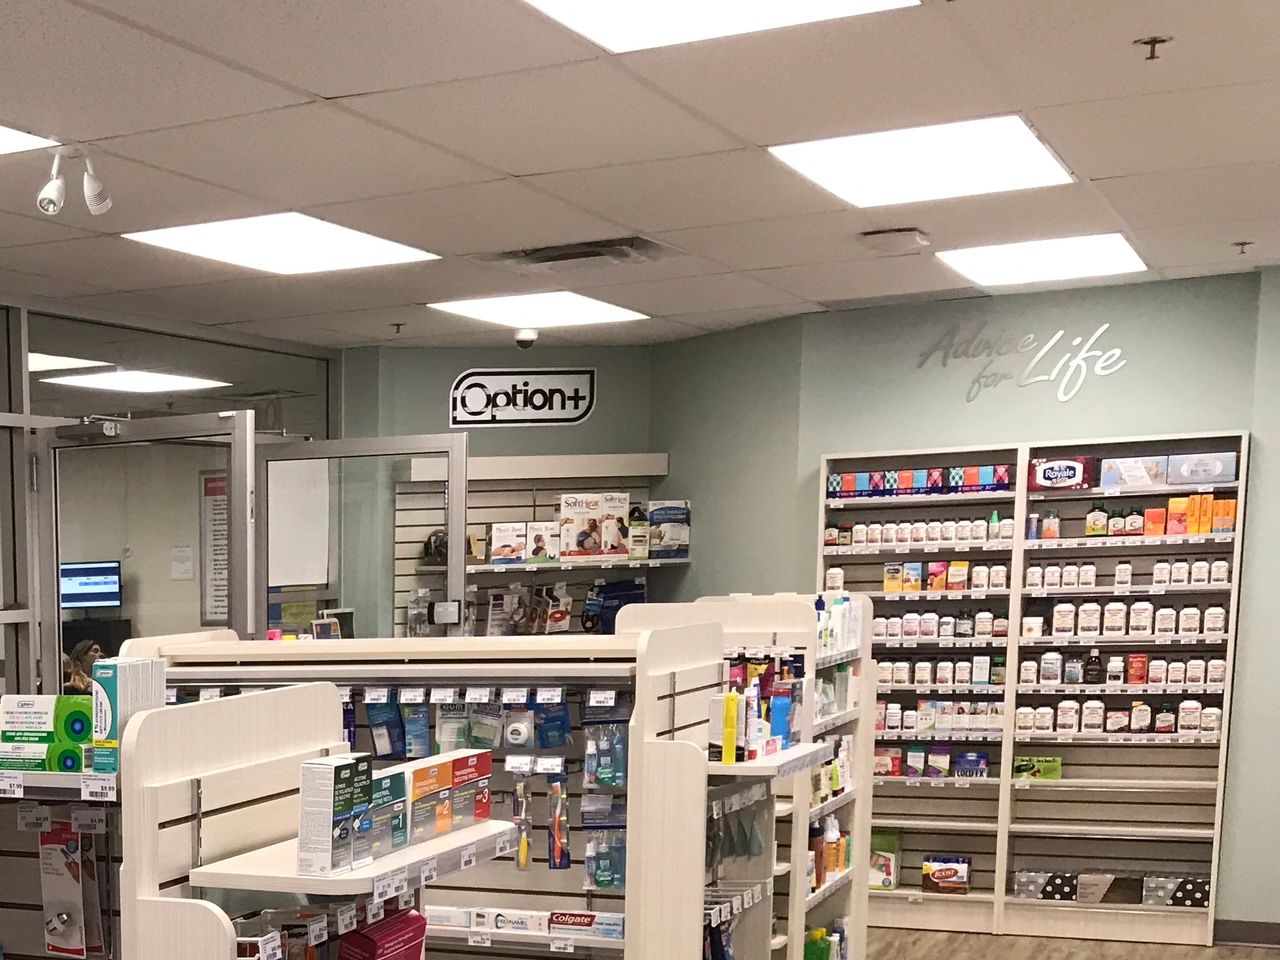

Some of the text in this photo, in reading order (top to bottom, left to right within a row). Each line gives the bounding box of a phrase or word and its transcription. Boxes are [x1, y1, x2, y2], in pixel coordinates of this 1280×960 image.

[917, 320, 1037, 368] Advice
[966, 323, 1127, 403] for Life
[461, 381, 586, 417] Option+
[1045, 469, 1074, 481] Royale
[483, 788, 489, 803] 3
[443, 800, 449, 815] 2
[552, 913, 592, 926] Colgate
